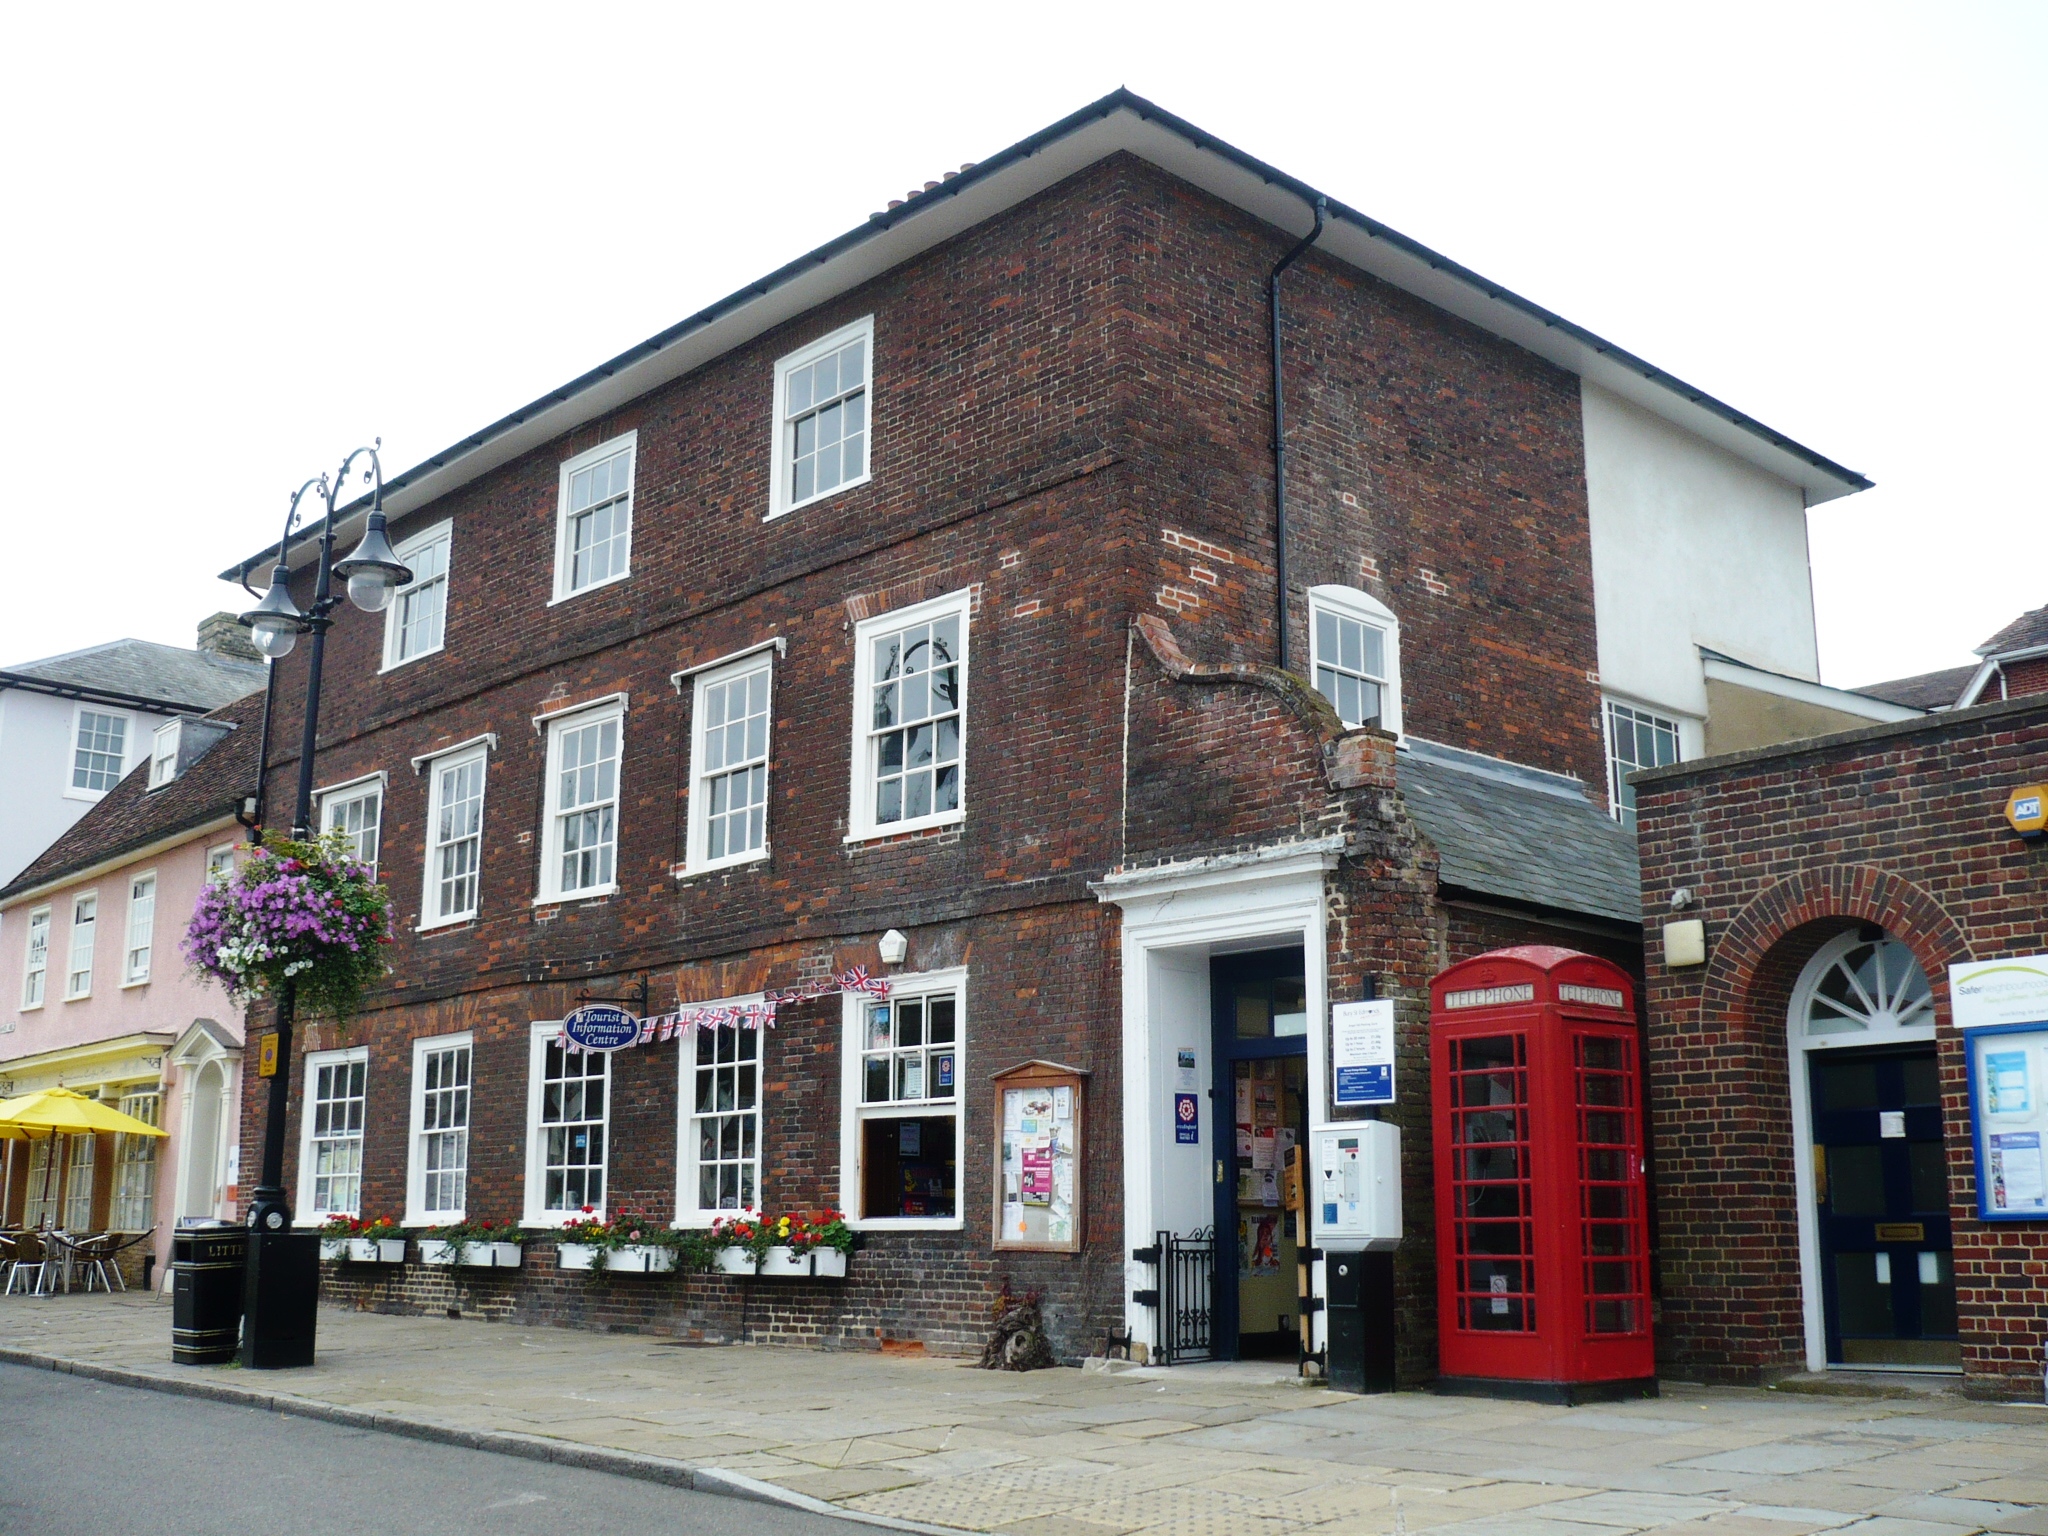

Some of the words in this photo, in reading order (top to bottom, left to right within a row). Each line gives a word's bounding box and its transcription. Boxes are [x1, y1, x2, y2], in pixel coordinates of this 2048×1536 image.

[2015, 801, 2040, 817] ADT
[1450, 985, 1532, 1006] TELEPHONE
[1560, 985, 1621, 1005] TELEPHONE
[584, 1010, 619, 1022] Tourist
[572, 1021, 632, 1036] Information
[585, 1034, 618, 1045] Centre
[209, 1245, 243, 1256] LITTE
